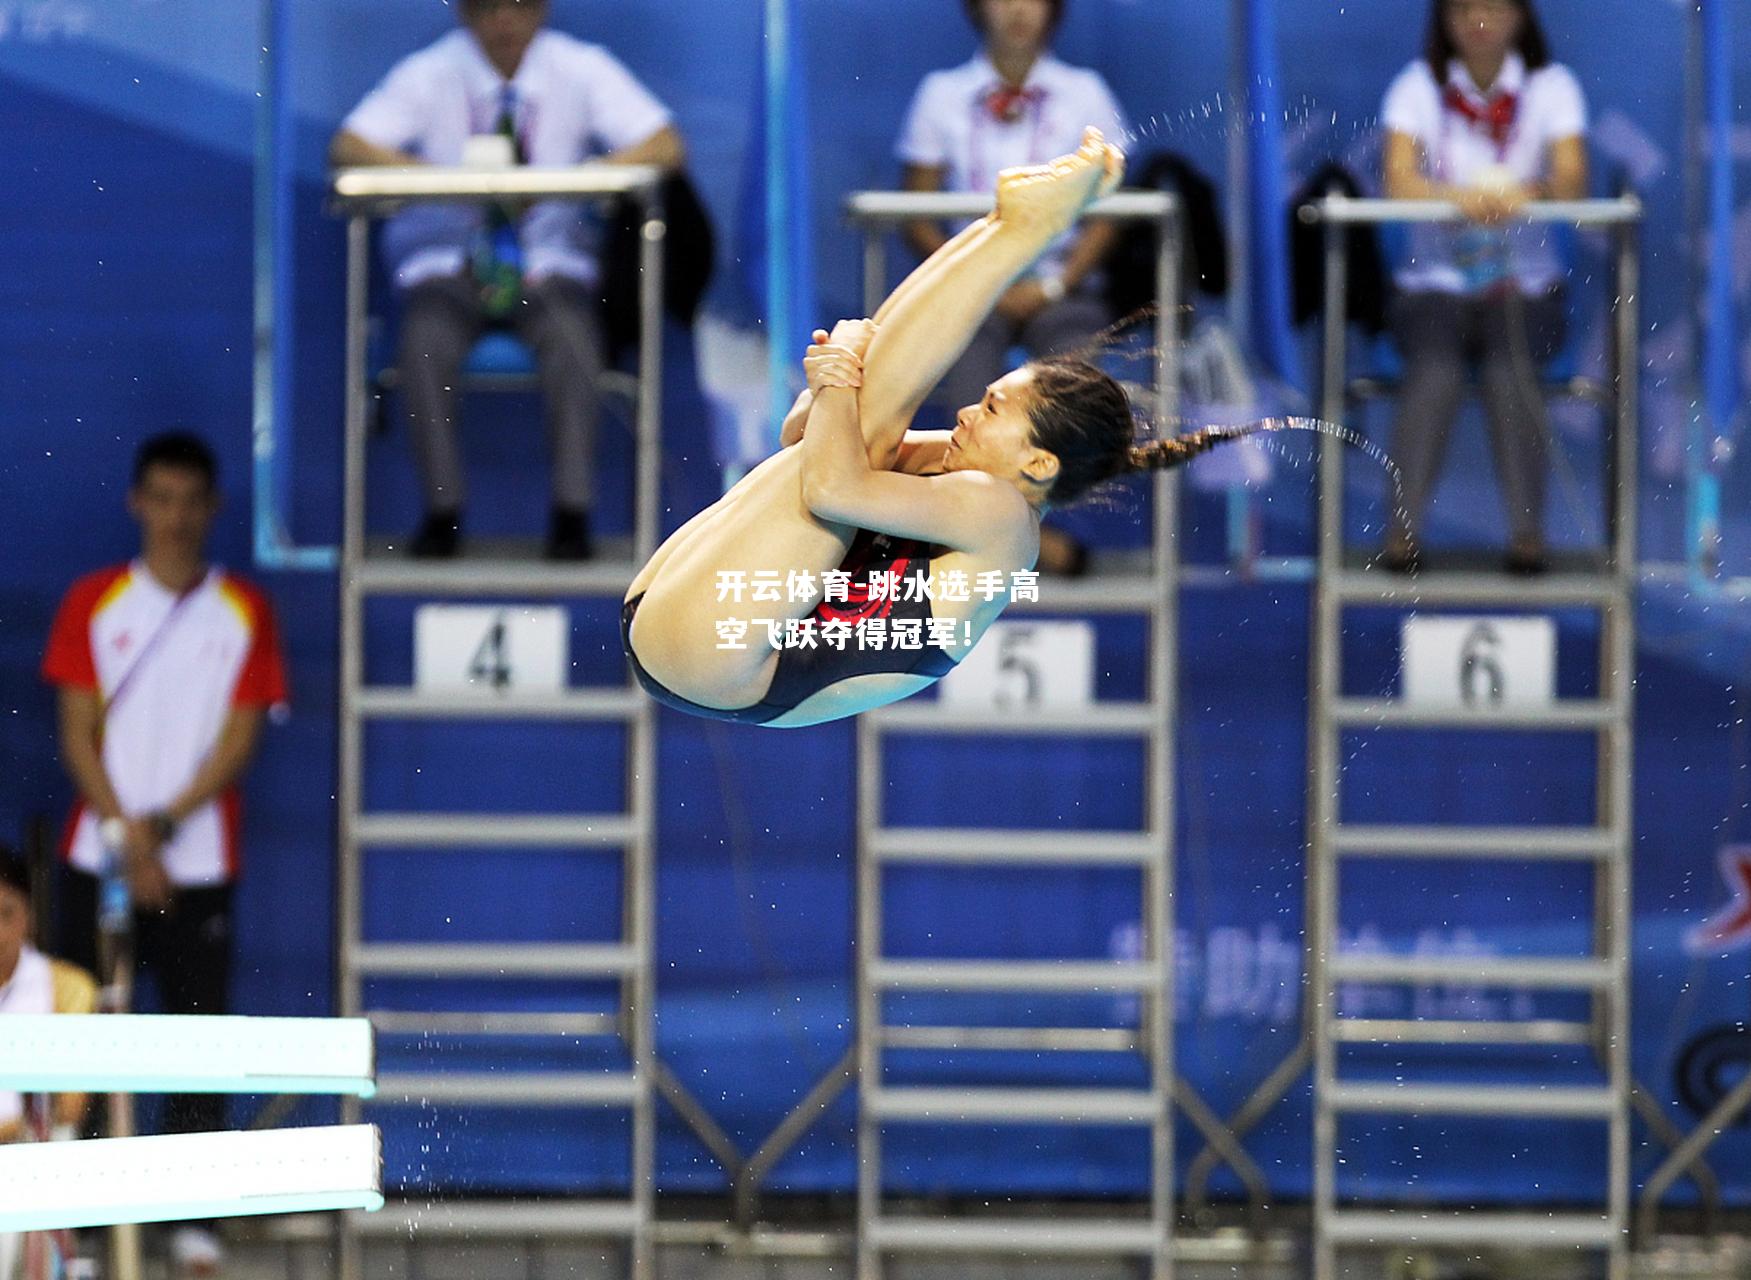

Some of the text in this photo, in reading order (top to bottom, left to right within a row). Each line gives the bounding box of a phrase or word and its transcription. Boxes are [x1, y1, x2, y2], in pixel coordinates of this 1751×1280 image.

[468, 614, 512, 690] 4
[994, 626, 1043, 707] 5
[1459, 620, 1505, 706] 6
